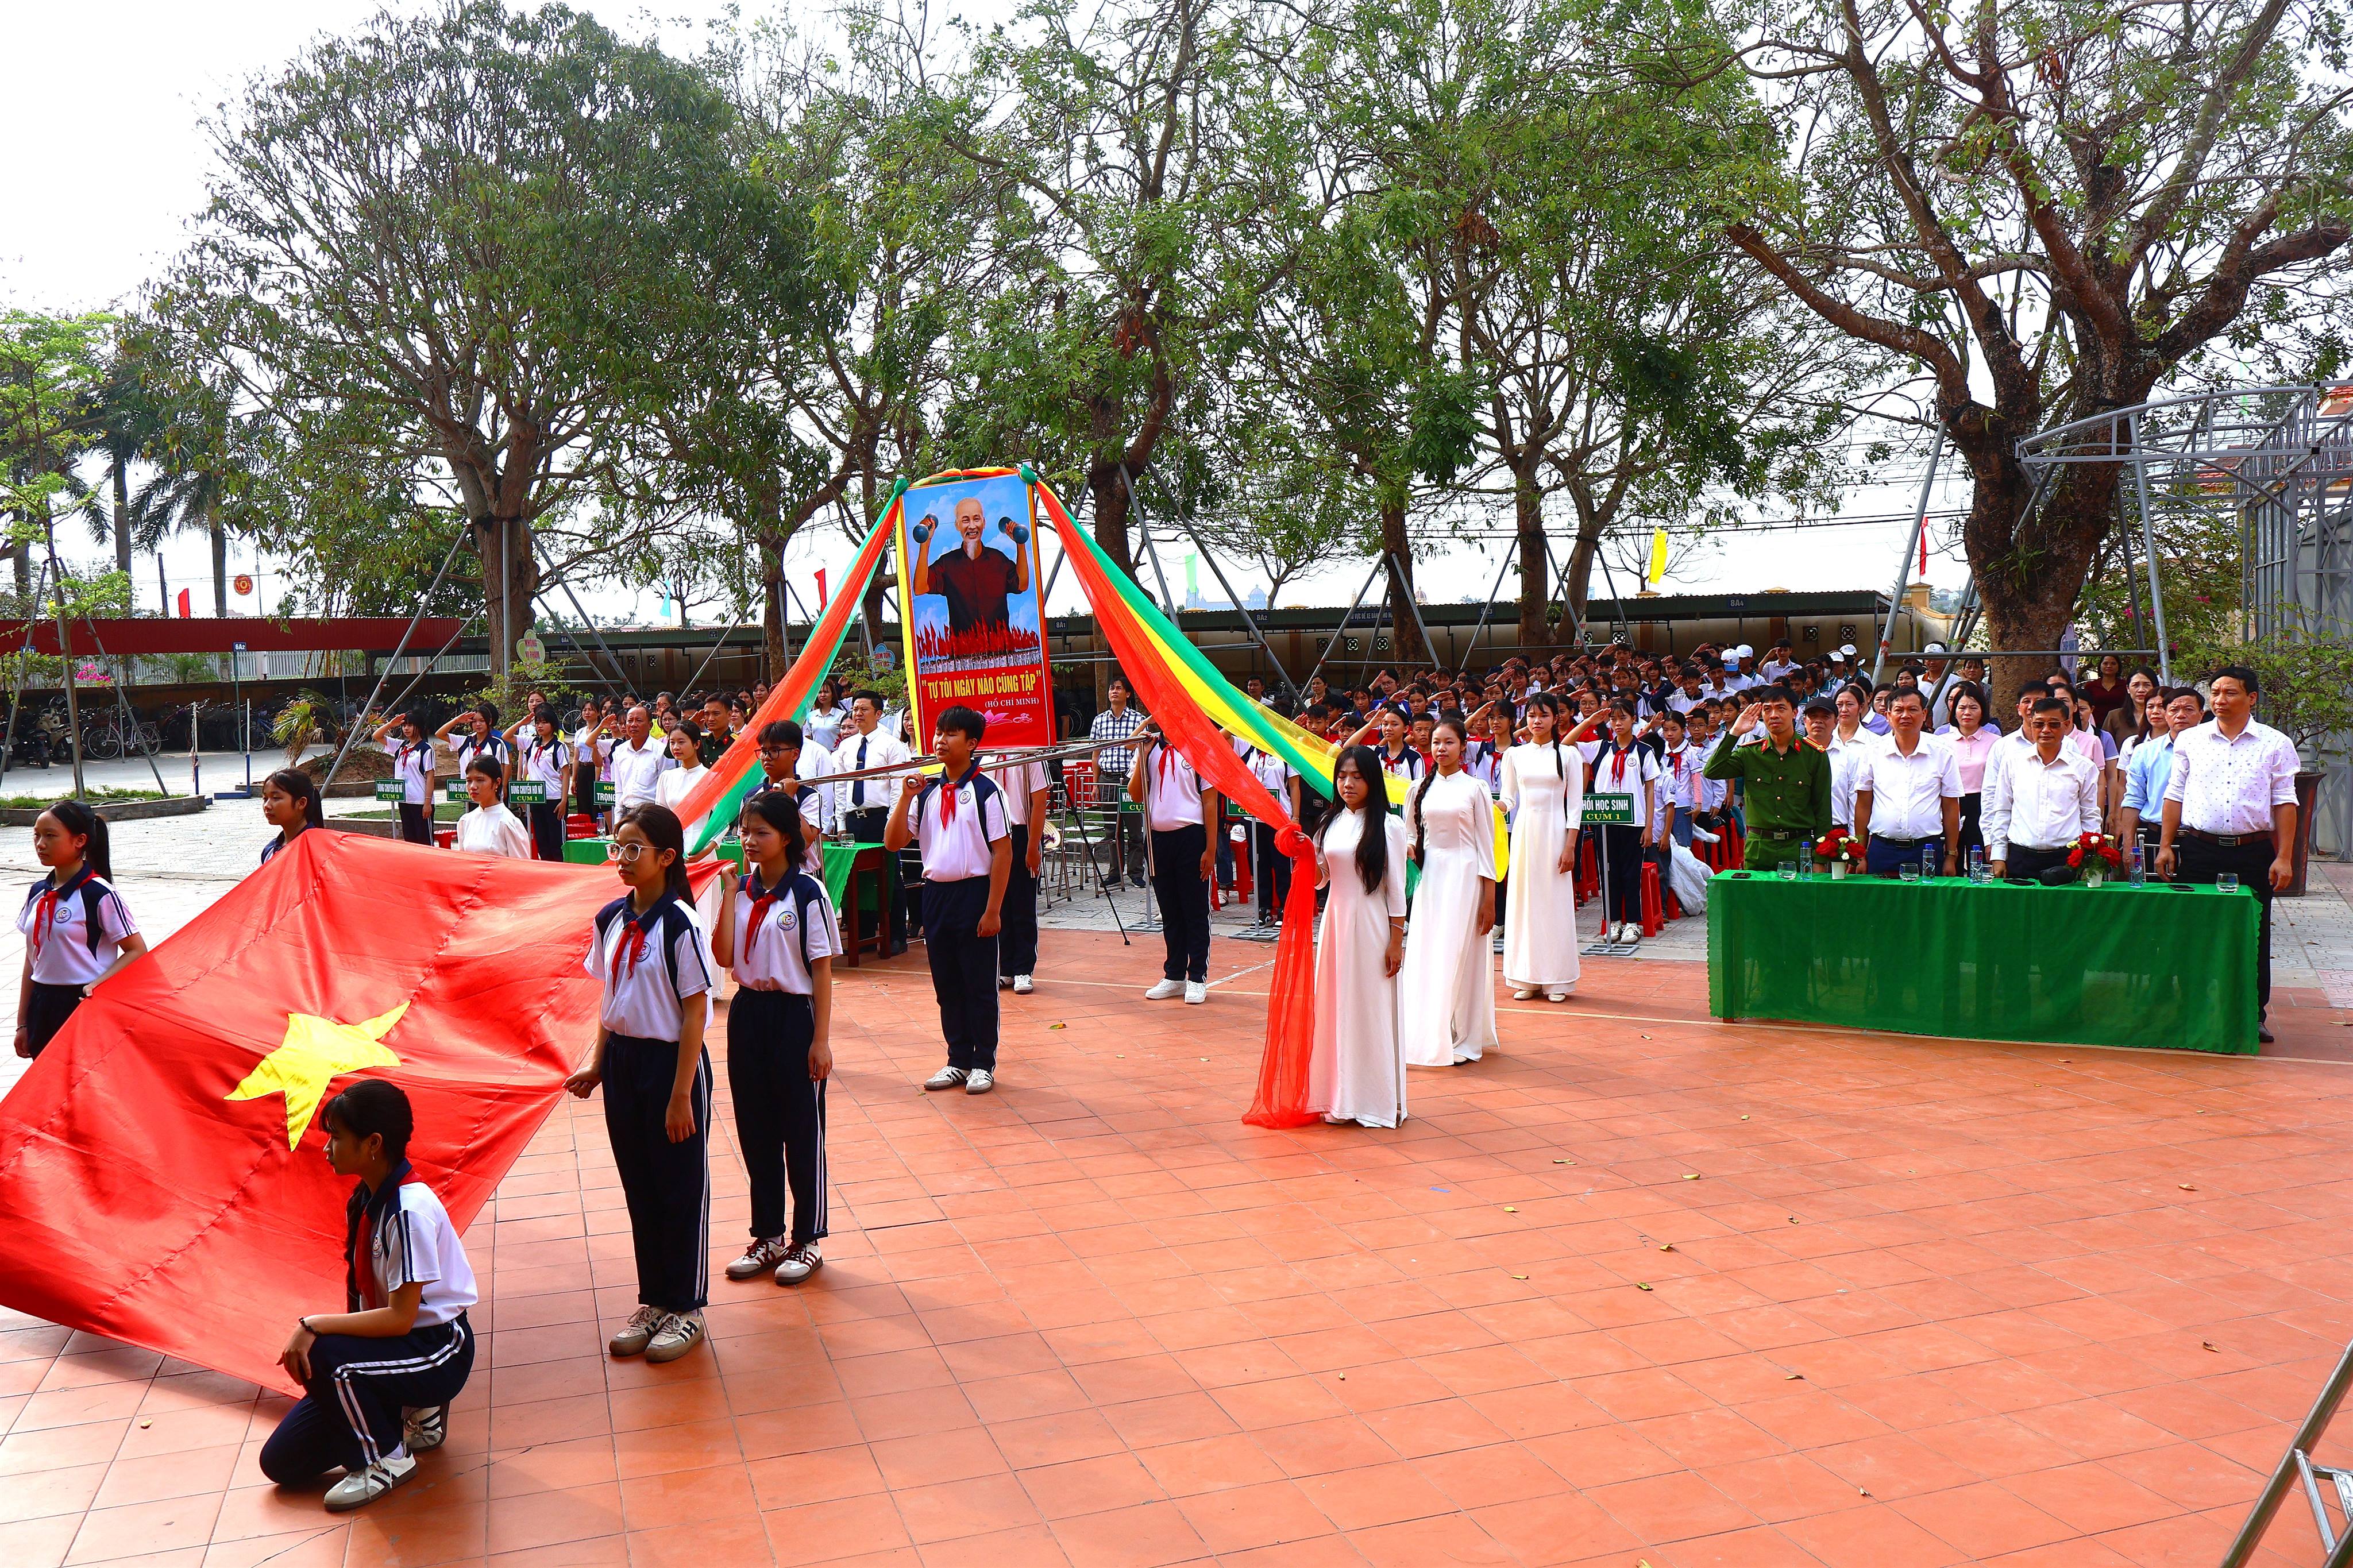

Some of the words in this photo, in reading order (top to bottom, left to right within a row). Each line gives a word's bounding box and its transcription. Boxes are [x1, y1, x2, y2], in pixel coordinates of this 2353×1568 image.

[939, 677, 952, 698] TÔI
[954, 675, 975, 697] NGÀY
[977, 674, 994, 695] NÀO
[996, 673, 1019, 694] CŨNG
[1000, 697, 1014, 706] CHÍ
[1016, 697, 1039, 705] MINH)
[1582, 796, 1594, 810] HỐI
[1595, 800, 1609, 813] HỌC
[1611, 800, 1629, 810] SINH
[1586, 813, 1612, 821] CỤM
